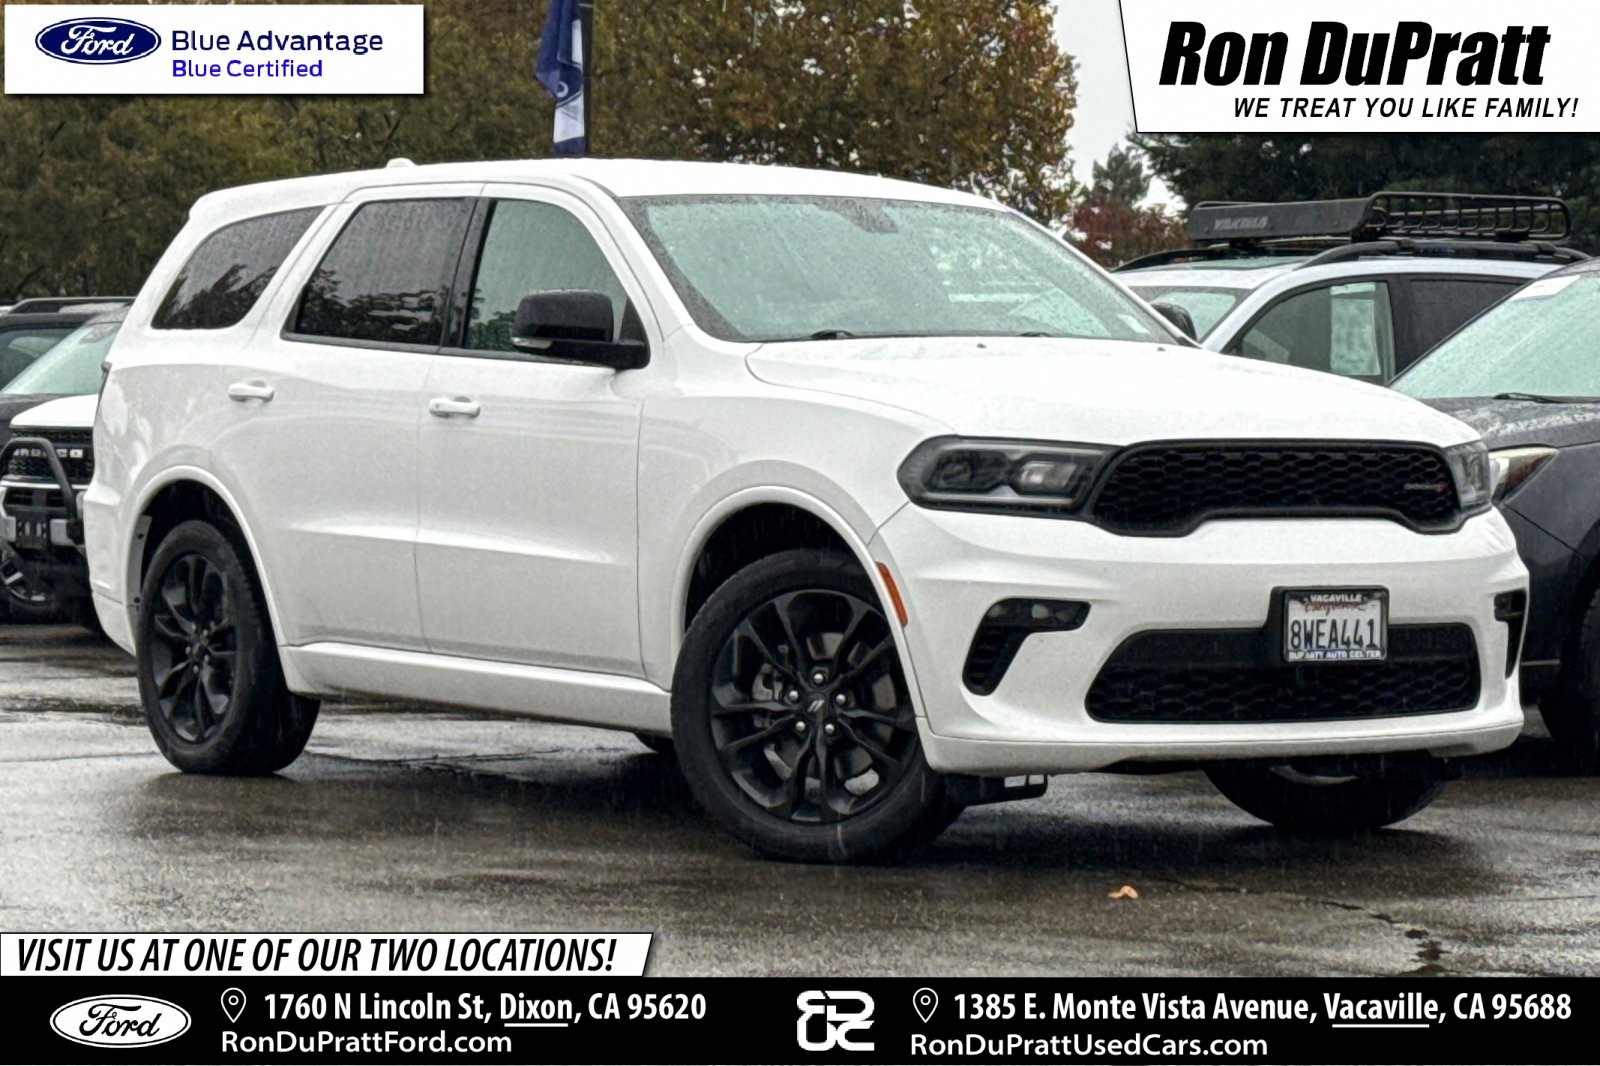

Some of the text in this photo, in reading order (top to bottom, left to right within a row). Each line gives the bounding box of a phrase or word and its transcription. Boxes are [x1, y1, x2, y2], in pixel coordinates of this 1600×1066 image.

[12, 448, 83, 458] ROCO
[1310, 594, 1363, 602] VACAVILLE
[1290, 618, 1378, 650] 8WEA441
[1326, 650, 1347, 659] AUTO
